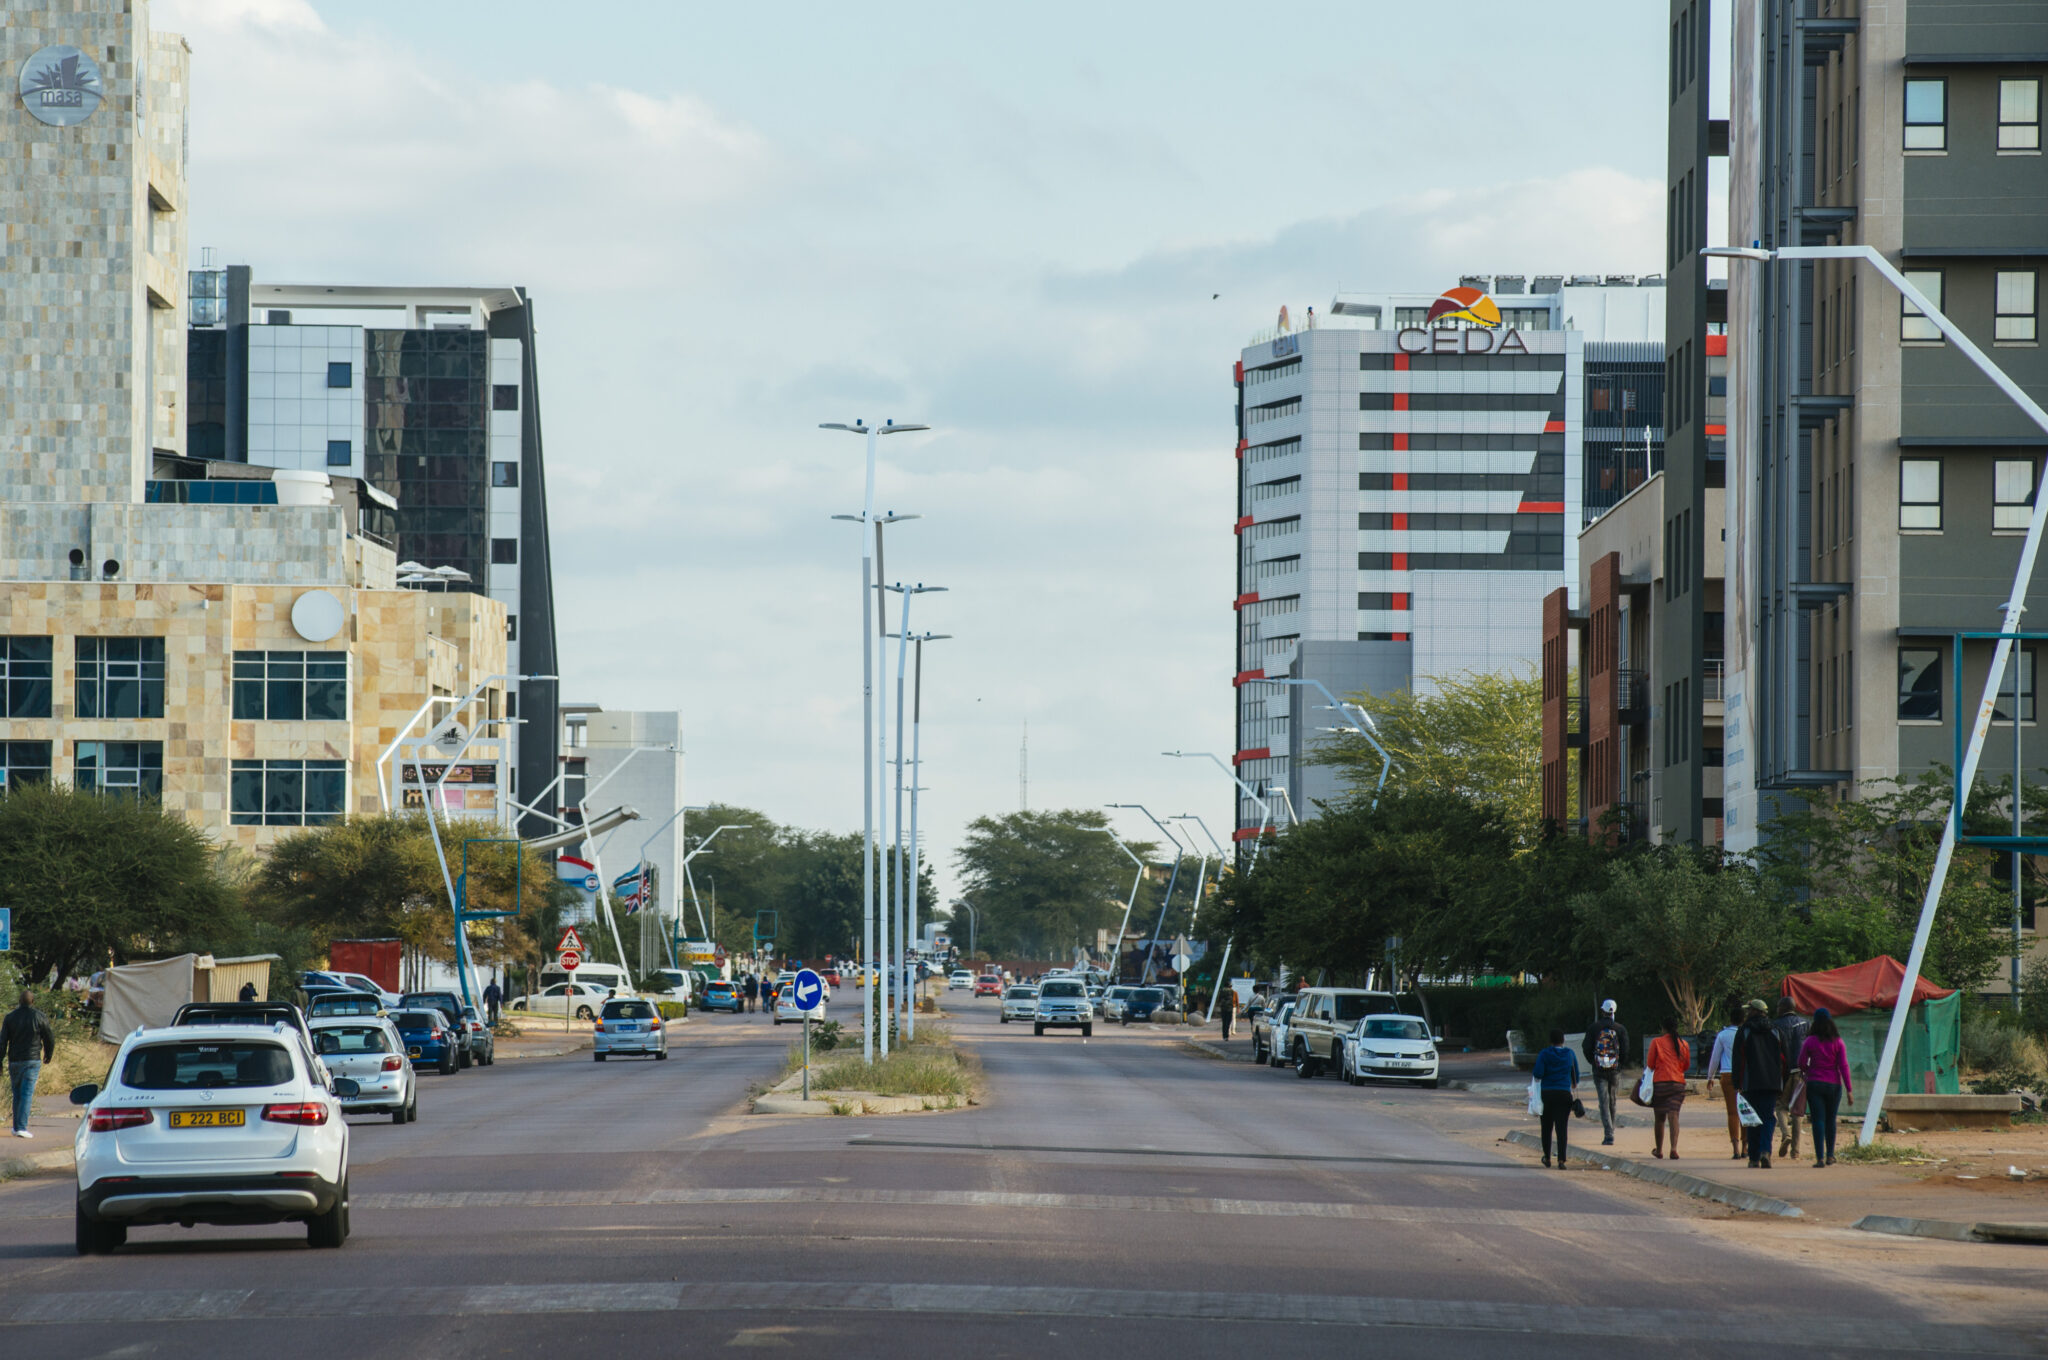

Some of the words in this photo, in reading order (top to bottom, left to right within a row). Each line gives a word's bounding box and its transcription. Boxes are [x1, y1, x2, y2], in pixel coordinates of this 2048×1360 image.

[41, 90, 82, 106] masa
[1398, 327, 1529, 354] CEDA
[561, 956, 579, 965] STOP
[173, 1114, 181, 1126] B
[190, 1113, 213, 1125] 222
[218, 1111, 241, 1124] BCI
